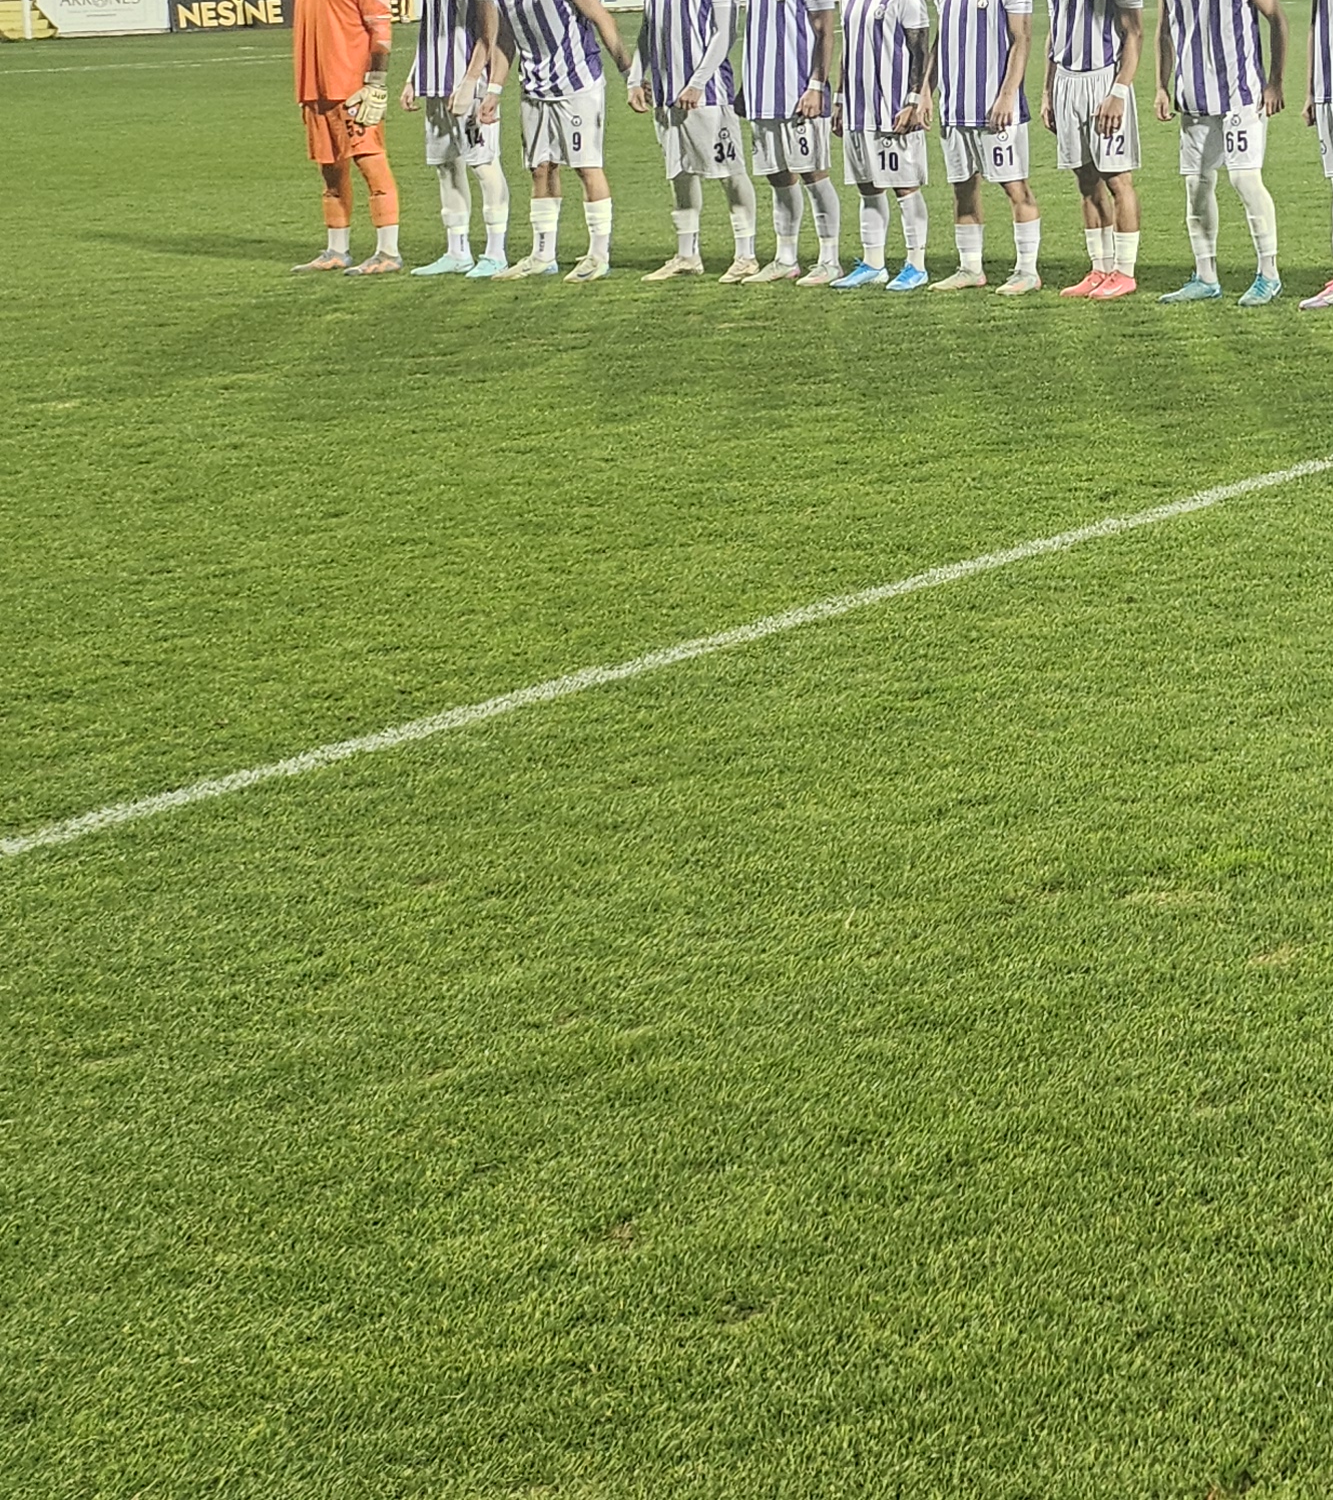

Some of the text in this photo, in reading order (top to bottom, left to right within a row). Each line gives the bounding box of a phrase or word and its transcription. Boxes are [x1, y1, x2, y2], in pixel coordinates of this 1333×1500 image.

[572, 132, 583, 152] 9
[713, 142, 737, 163] 34
[799, 136, 809, 157] 8
[1103, 134, 1126, 156] 72
[1225, 131, 1248, 153] 65
[878, 150, 899, 172] 10
[992, 145, 1014, 167] 61
